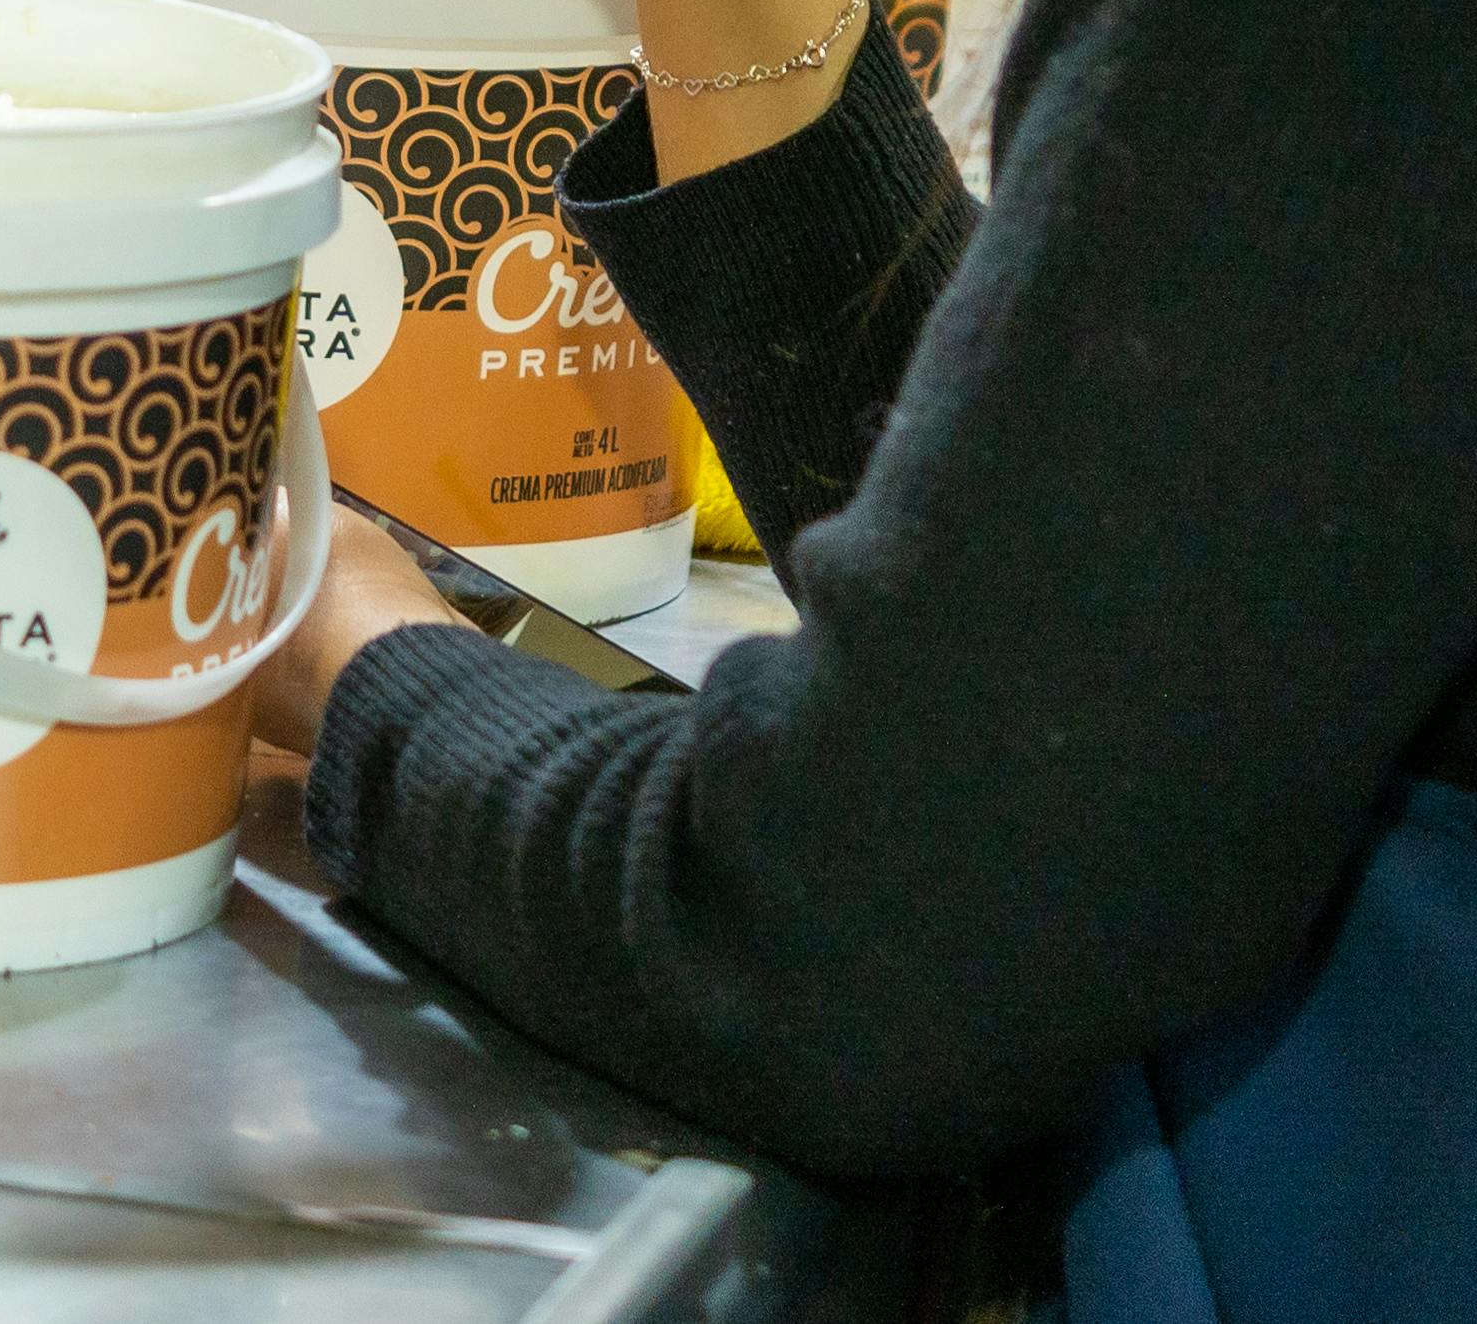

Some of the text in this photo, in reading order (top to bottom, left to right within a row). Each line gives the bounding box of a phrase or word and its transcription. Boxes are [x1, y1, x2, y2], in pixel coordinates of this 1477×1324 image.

[477, 229, 625, 334] Cre
[480, 338, 661, 380] PREMIU
[598, 427, 609, 454] 4
[611, 426, 620, 453] L
[490, 473, 541, 504] CREMA
[544, 467, 606, 501] PREMIUM
[171, 507, 270, 643] Cre
